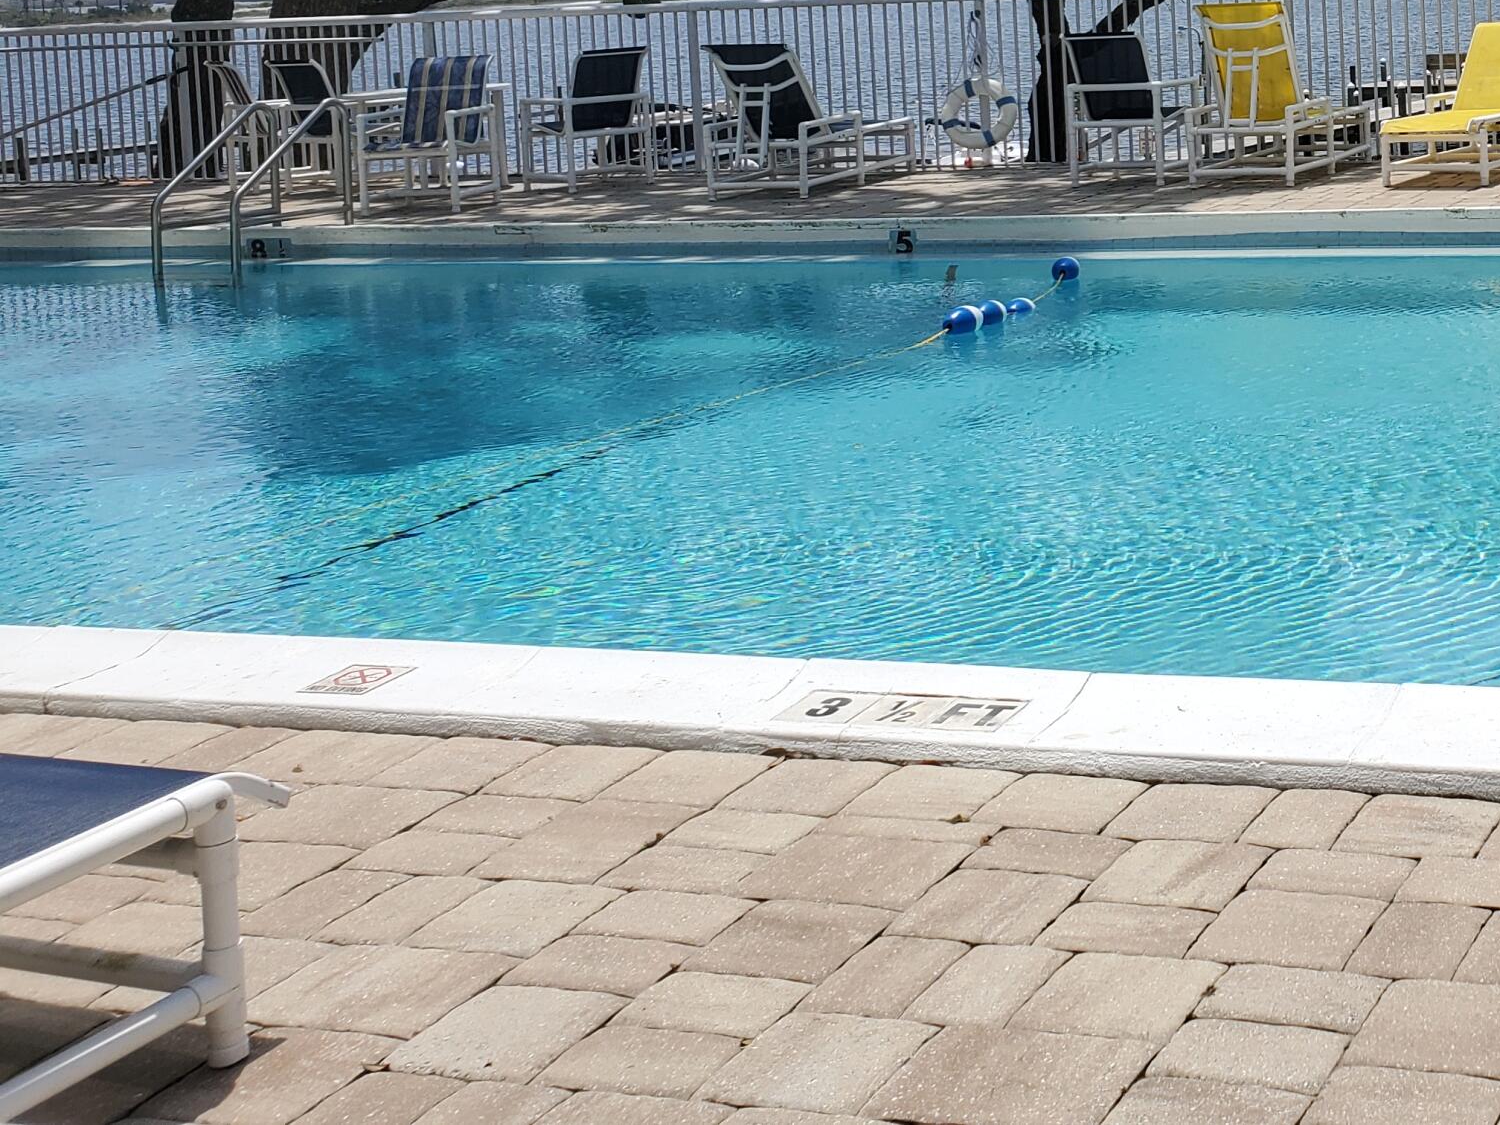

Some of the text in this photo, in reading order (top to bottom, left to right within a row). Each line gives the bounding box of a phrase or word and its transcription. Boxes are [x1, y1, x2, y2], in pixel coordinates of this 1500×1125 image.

[251, 239, 267, 259] 8
[896, 230, 913, 253] 5
[804, 697, 852, 718] 3
